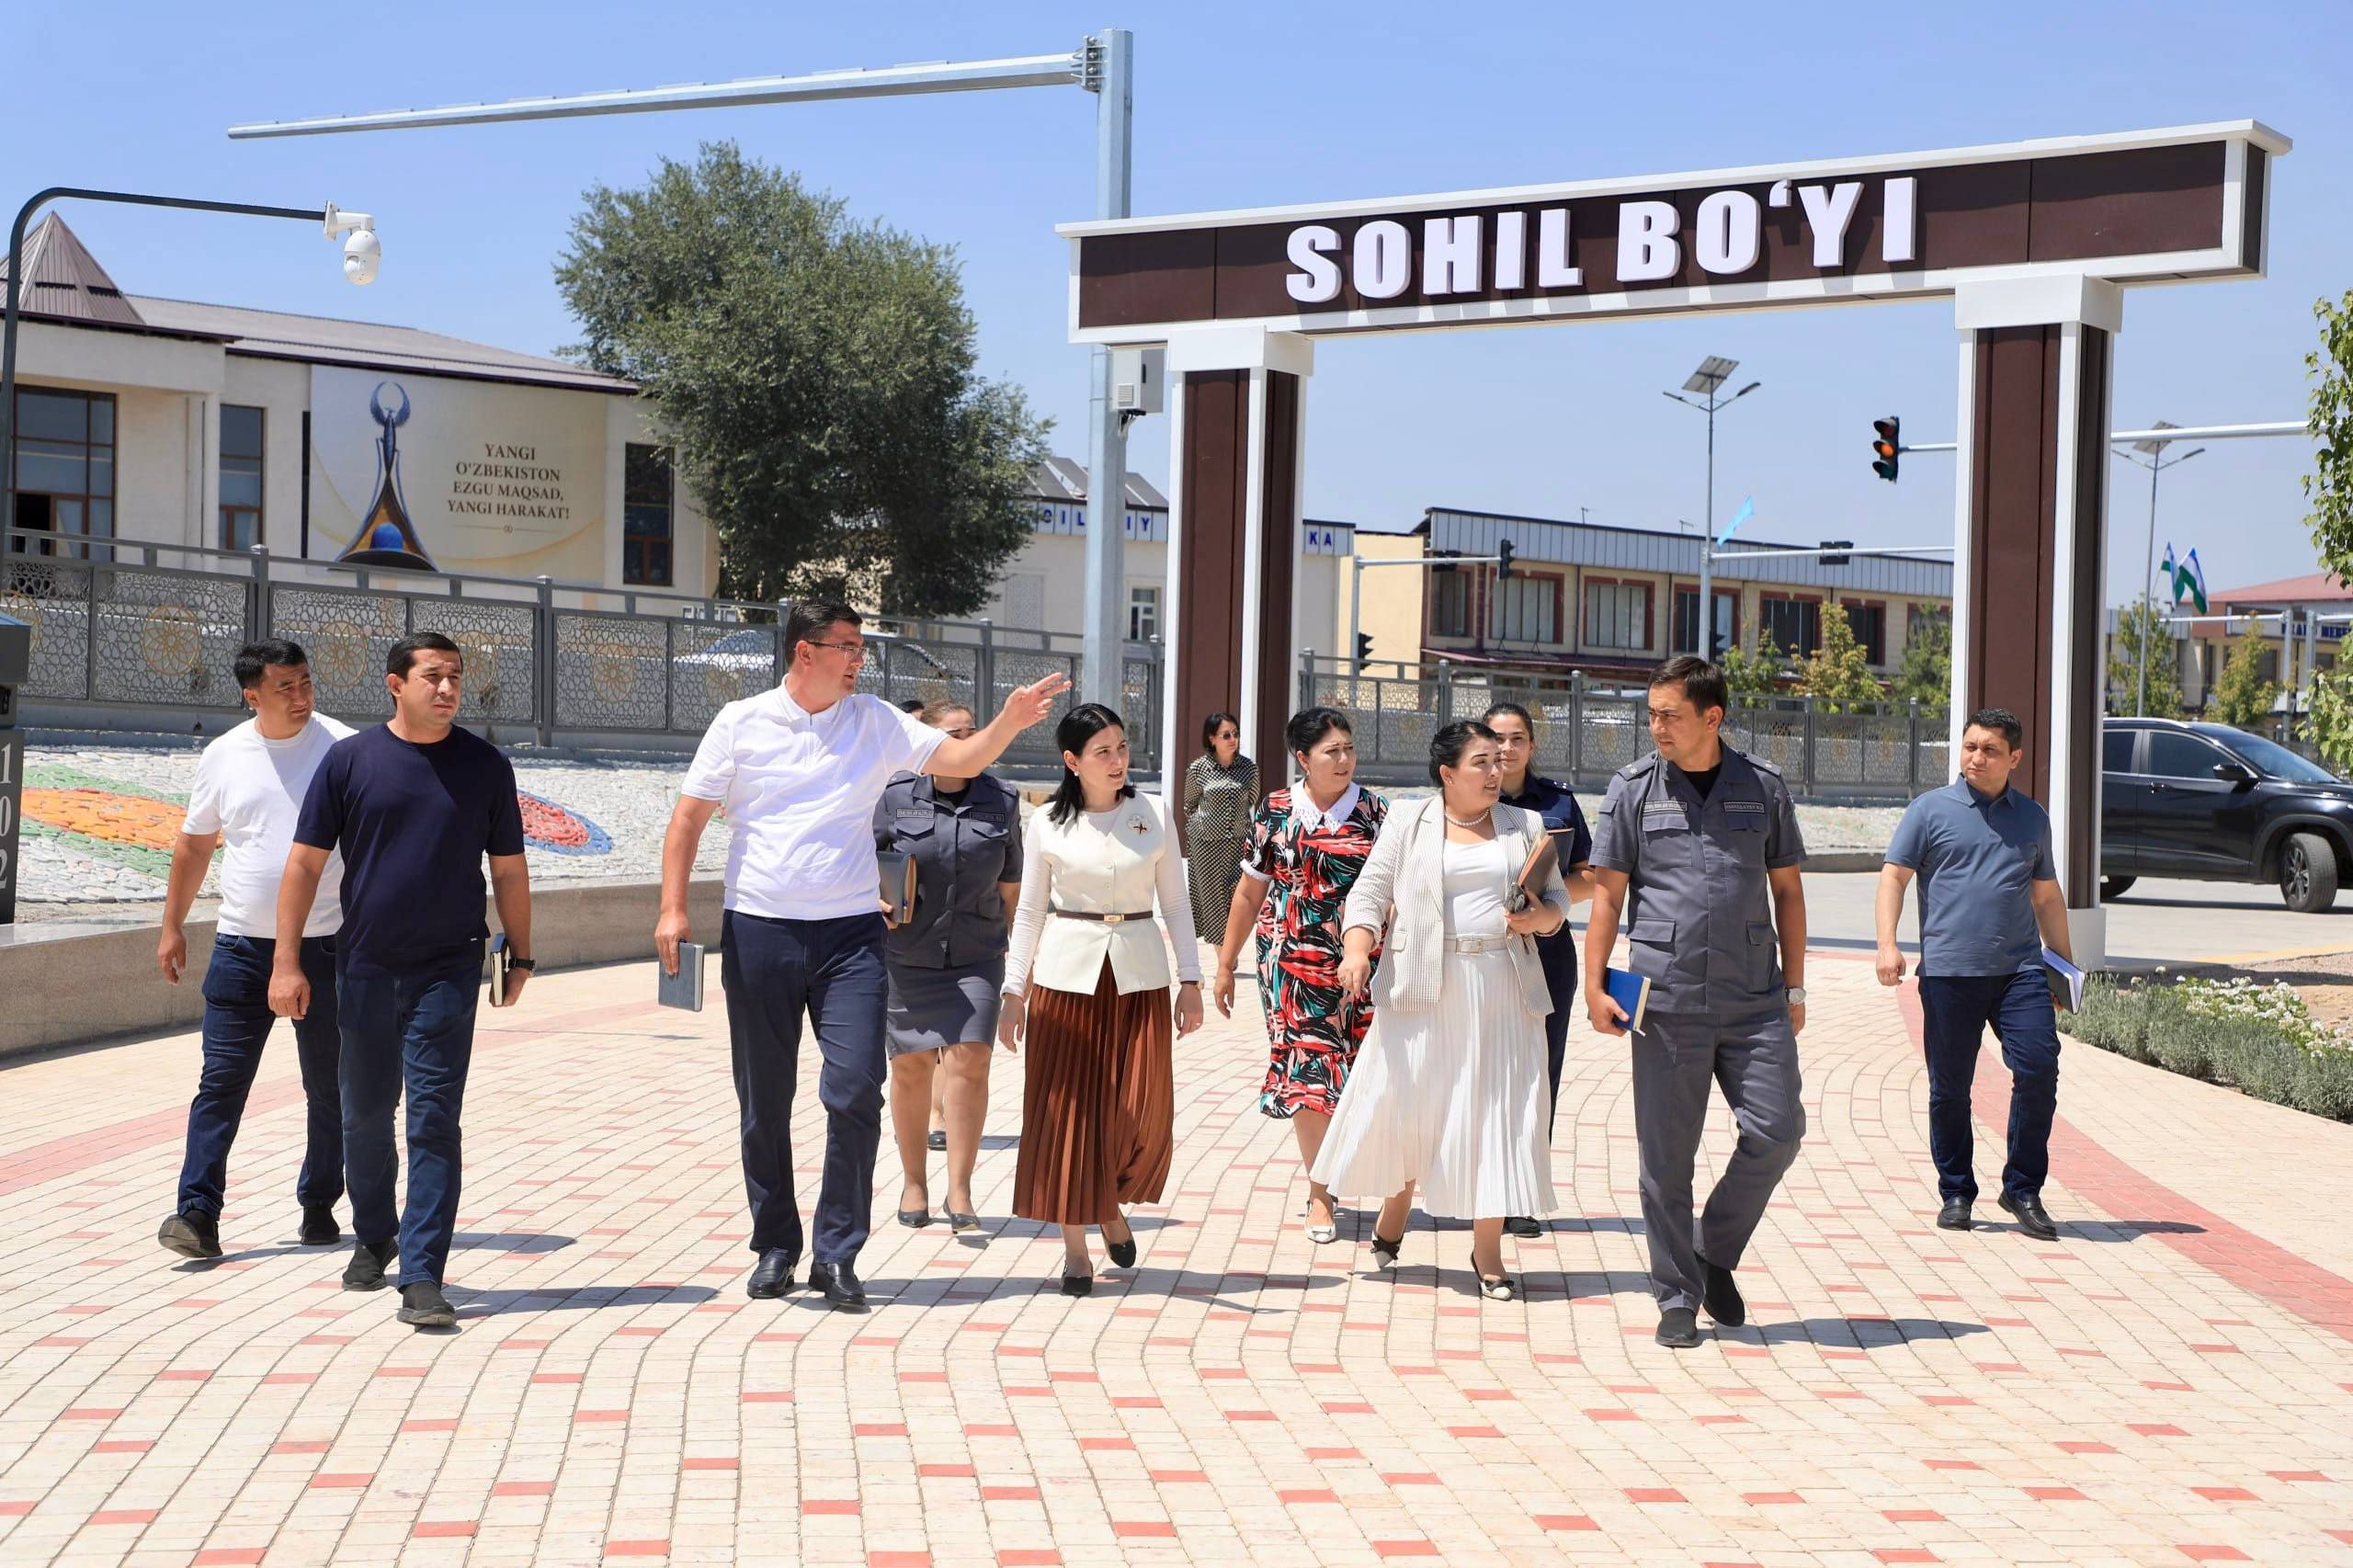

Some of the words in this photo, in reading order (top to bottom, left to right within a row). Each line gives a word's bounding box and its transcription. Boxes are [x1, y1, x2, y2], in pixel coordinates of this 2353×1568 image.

[1286, 209, 1584, 303] SOHIL
[485, 443, 536, 460] YANGI
[453, 481, 494, 495] EZGU
[497, 483, 564, 502] MAQSAD,
[448, 499, 492, 515] YANGI
[496, 504, 570, 519] HARAKAT!
